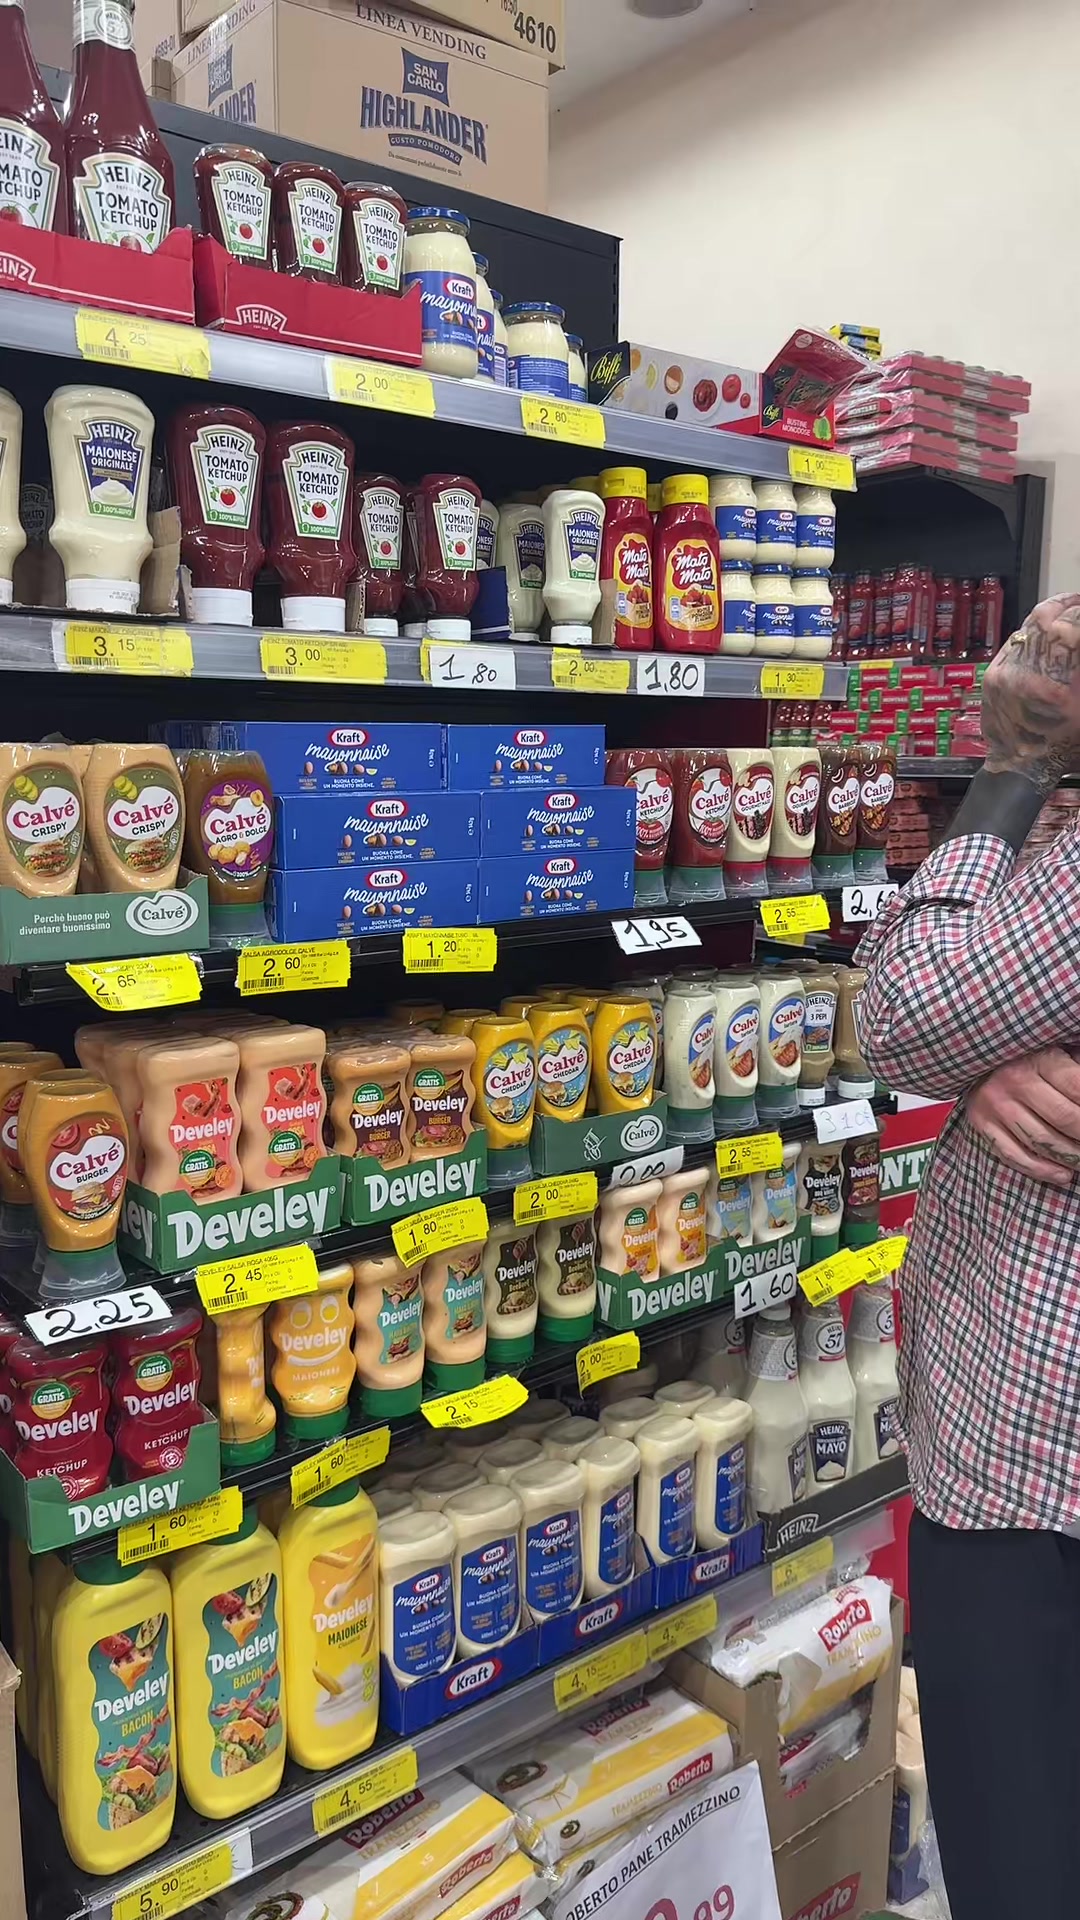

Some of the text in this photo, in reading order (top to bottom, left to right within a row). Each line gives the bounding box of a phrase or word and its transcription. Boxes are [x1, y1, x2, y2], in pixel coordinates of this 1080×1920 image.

[357, 3, 487, 60] LINEA VENDING
[514, 11, 556, 53] 4610
[414, 62, 438, 80] SAN
[407, 73, 444, 94] CARLO
[360, 85, 488, 166] HIGHLANDER
[417, 138, 460, 164] POMODORO
[102, 165, 151, 193] HEINZ
[228, 170, 257, 187] HEINZ
[223, 189, 263, 208] TOMATO
[304, 187, 331, 204] HEINZ
[95, 191, 159, 219] TOMATO
[226, 202, 263, 218] KETCHUP
[100, 209, 158, 232] KETCHUP
[299, 204, 335, 225] TOMATO
[369, 207, 394, 223] HEINZ
[301, 216, 335, 234] KETCHUP
[363, 223, 398, 241] TOMATO
[366, 235, 397, 251] KETCHUP
[451, 282, 472, 298] Kraft
[242, 307, 282, 328] HEINZ
[590, 350, 623, 386] Biffi
[92, 424, 134, 444] HEINZ
[782, 424, 810, 436] MONODOSE
[210, 435, 246, 451] HEINZ
[86, 444, 137, 463] MAIONESE
[300, 451, 335, 468] HEINZ
[91, 458, 134, 471] ORIGINALE
[205, 455, 249, 473] TOMATO
[207, 468, 248, 483] KETCHUP
[297, 470, 339, 485] TOMATO
[299, 482, 338, 496] KETCHUP
[370, 496, 394, 510] HEINZ
[447, 496, 470, 509] HEINZ
[367, 513, 399, 525] TOMATO
[444, 513, 474, 525] TOMATO
[574, 513, 596, 524] HEINZ
[370, 523, 398, 534] KETCHUP
[445, 524, 473, 534] KETCHUP
[568, 529, 599, 539] MAIONESE
[572, 537, 597, 545] ORIGINALE
[623, 547, 647, 564] Mato
[675, 552, 708, 570] Mato
[626, 564, 649, 579] Mato
[680, 567, 711, 585] Mato
[644, 659, 700, 691] 1,80
[336, 732, 361, 743] Kraft
[520, 733, 540, 742] Kraft
[305, 743, 390, 772] mayonnaise
[495, 743, 563, 769] mayonnaise
[738, 788, 772, 808] Calvé
[789, 786, 818, 804] Calvé
[864, 781, 892, 797] Calvé
[375, 804, 399, 814] Kraft
[552, 797, 571, 806] Kraft
[694, 790, 729, 810] Calvé
[12, 796, 75, 829] Calvé
[113, 796, 175, 829] Calvé
[639, 806, 664, 818] KETCHUP
[704, 804, 726, 816] KETCHUP
[131, 819, 167, 836] CRISPY
[210, 811, 267, 835] Calvé
[527, 806, 595, 833] mayonnaise
[31, 821, 67, 838] CRISPY
[216, 825, 268, 845] AGRO DOLCE
[344, 814, 429, 844] mayonnaise
[550, 858, 571, 872] Kraft
[374, 872, 399, 885] Kraft
[525, 870, 594, 900] mayonnaise
[343, 882, 427, 916] mayonnaise
[66, 912, 93, 922] buono
[95, 911, 110, 923] può
[141, 905, 185, 921] Calvé
[19, 921, 111, 936] diventare buonissimo
[623, 918, 688, 950] 1,95
[243, 949, 298, 958] SALSA AGRODOLCE
[613, 1040, 652, 1064] Calvé
[542, 1051, 585, 1075] Calvé
[622, 1056, 647, 1071] CHEDDAR
[489, 1064, 531, 1089] Calvé
[553, 1066, 579, 1080] CHEDDAR
[418, 1079, 440, 1087] GRATIS
[501, 1079, 526, 1095] CHEDDAR
[264, 1101, 321, 1124] Develey
[412, 1095, 465, 1112] Develey
[352, 1110, 404, 1129] Develey
[170, 1117, 234, 1143] Develey
[369, 1131, 391, 1141] BURGER
[274, 1141, 296, 1153] GRATIS
[56, 1143, 120, 1178] Calvé
[185, 1161, 209, 1172] GRATIS
[76, 1167, 109, 1183] BURGER
[364, 1156, 478, 1212] Develey
[168, 1187, 328, 1260] Develey
[557, 1241, 594, 1263] Develey
[724, 1237, 803, 1281] Develey
[497, 1259, 536, 1281] Develey
[445, 1279, 483, 1303] Develey
[627, 1269, 716, 1322] Develey
[741, 1273, 794, 1312] 1,60
[46, 1292, 154, 1338] 2,25
[380, 1301, 422, 1328] Develey
[825, 1332, 844, 1348] 57
[140, 1363, 167, 1378] GRATIS
[37, 1390, 65, 1404] GRATIS
[123, 1379, 197, 1417] Develey
[15, 1408, 100, 1444] Develey
[819, 1424, 845, 1436] HEINZ
[144, 1428, 189, 1450] KETCHUP
[816, 1441, 847, 1455] MAYO
[68, 1480, 179, 1537] Develey
[548, 1522, 565, 1532] Kraft
[485, 1549, 502, 1560] Kraft
[419, 1576, 436, 1589] Kraft
[313, 1592, 374, 1633] Develey
[583, 1608, 614, 1632] Kraft
[328, 1618, 368, 1646] MAIONESE
[821, 1601, 867, 1646] Roberto
[208, 1628, 278, 1675] Develey
[233, 1666, 263, 1689] BACON
[454, 1667, 490, 1693] Kraft
[94, 1672, 169, 1722] Develey
[121, 1710, 153, 1737] BACON
[669, 1760, 712, 1792] Roberto
[620, 1847, 654, 1884] PANE
[654, 1786, 740, 1853] TRAMEZZINO
[439, 1851, 494, 1896] Roberto
